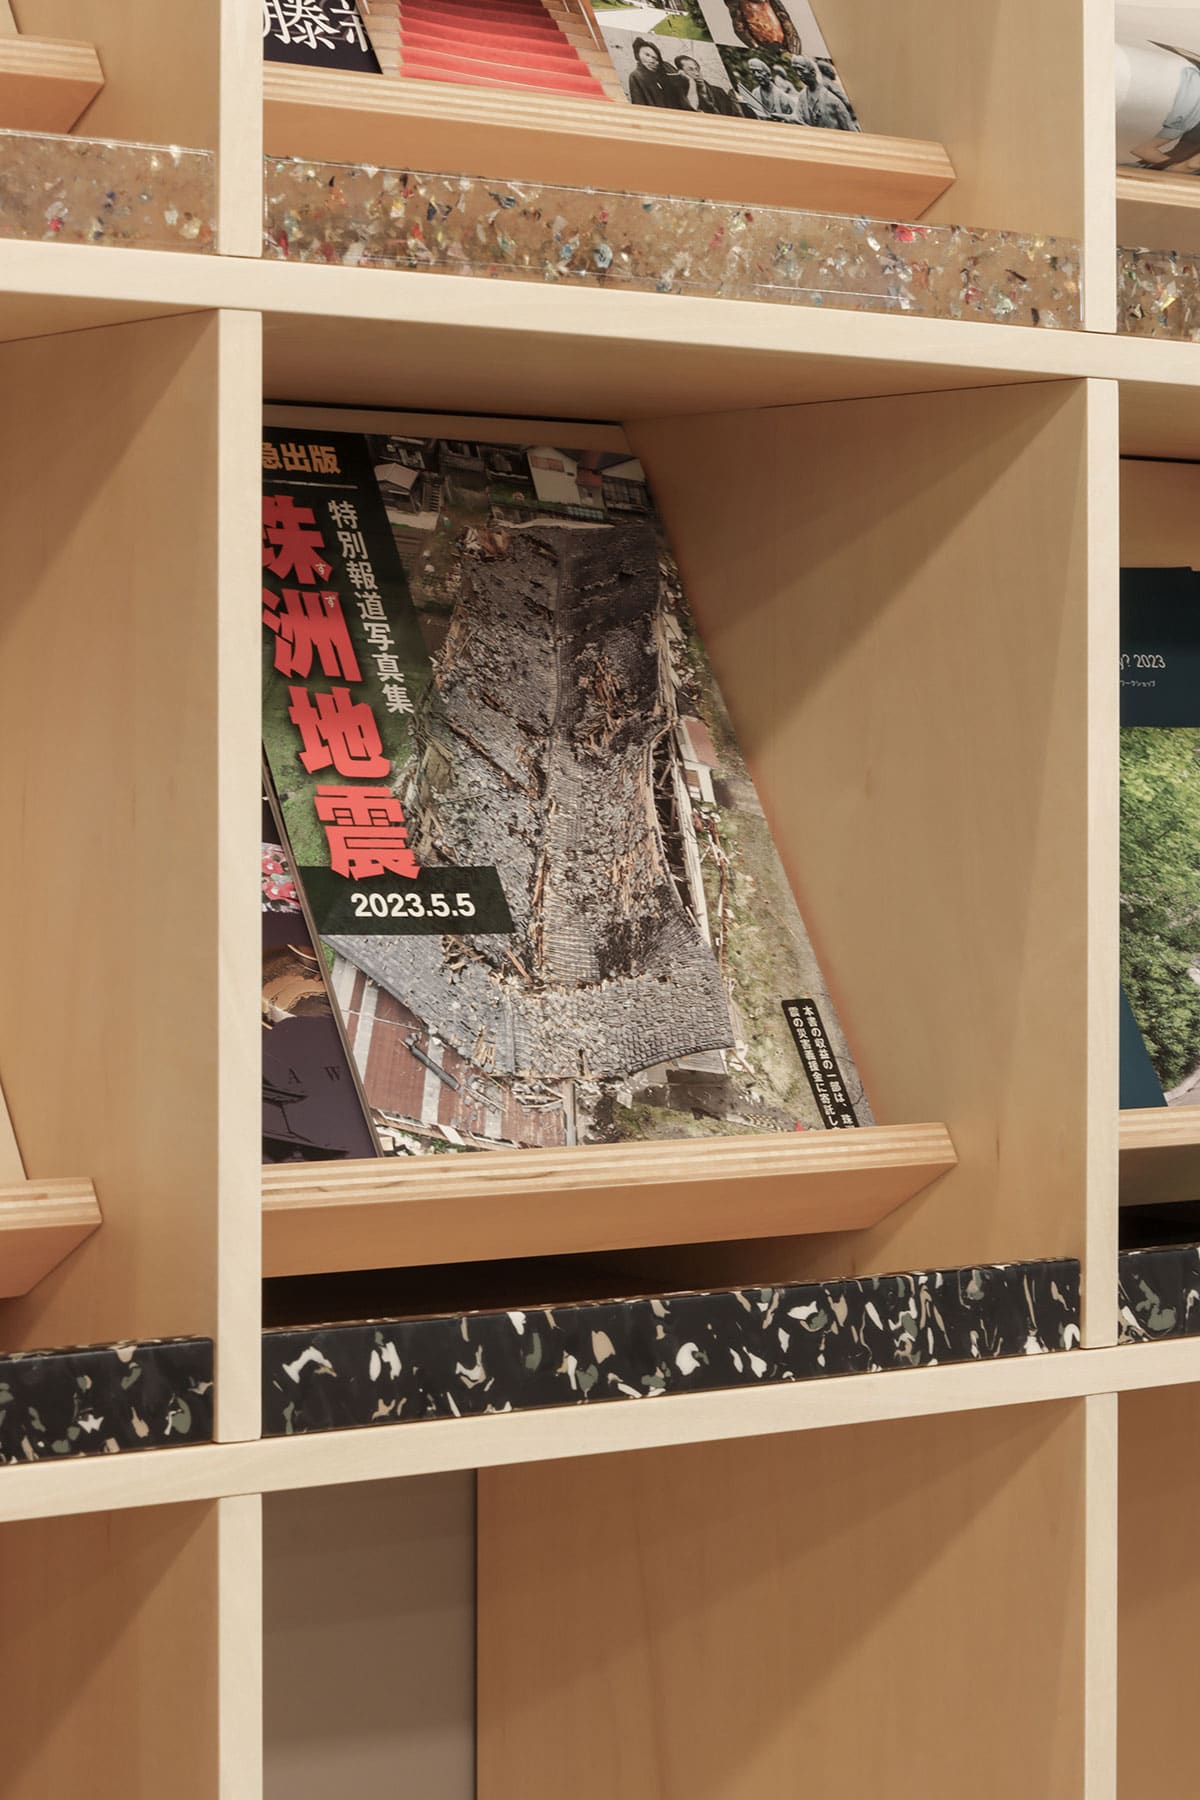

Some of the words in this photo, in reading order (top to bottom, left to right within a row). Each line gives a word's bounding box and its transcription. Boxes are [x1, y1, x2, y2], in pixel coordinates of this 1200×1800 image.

[327, 500, 415, 714] 特別報道写真集
[1133, 654, 1166, 668] 2023
[262, 495, 421, 881] 珠洲地震
[351, 893, 476, 917] 2023.5.5
[802, 1005, 855, 1129] 本書の収益の一部は、珠
